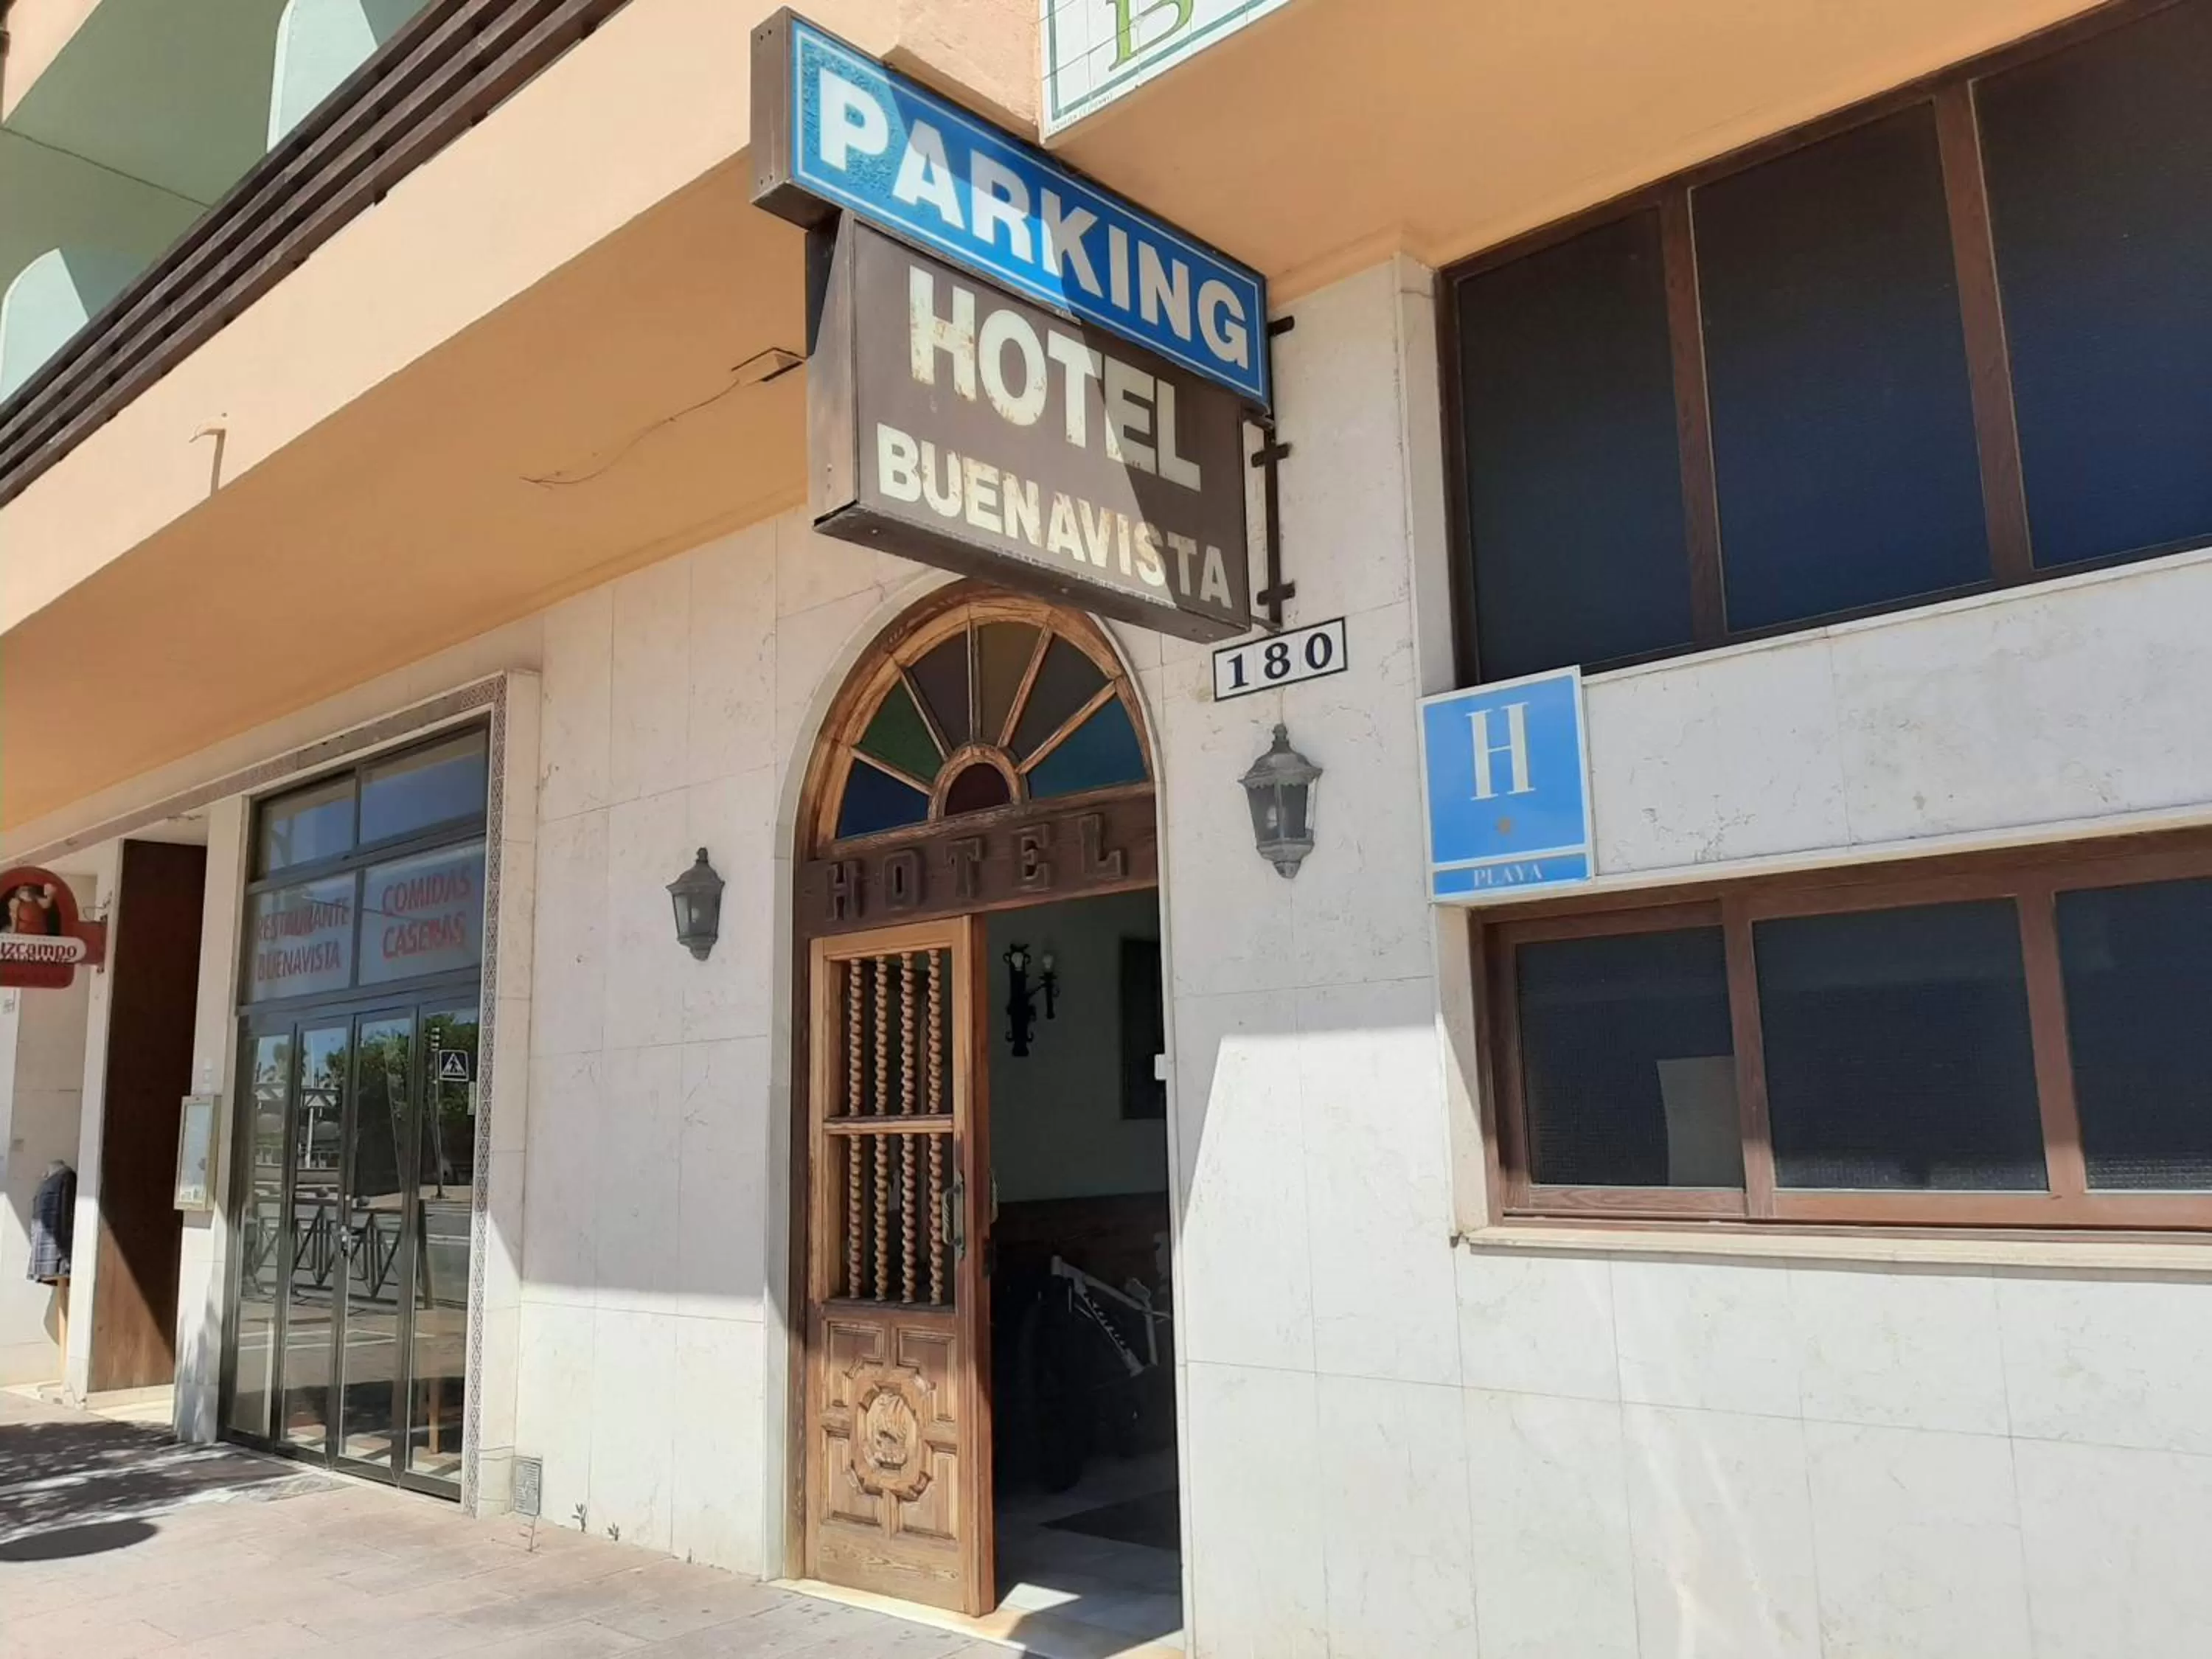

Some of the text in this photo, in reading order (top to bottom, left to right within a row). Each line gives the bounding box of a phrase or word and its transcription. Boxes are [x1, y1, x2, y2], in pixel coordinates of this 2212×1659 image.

[817, 69, 1249, 371] PARKING
[908, 265, 1202, 493] HOTEL
[876, 422, 1234, 610] BUENAVISTA
[1226, 632, 1333, 690] 180
[1465, 701, 1536, 801] H
[380, 864, 473, 917] COMIDAS
[826, 813, 1128, 922] HOTEL
[1474, 862, 1543, 887] PLAYA
[256, 940, 341, 981] BUENAVISTA
[380, 911, 467, 961] CASERAS
